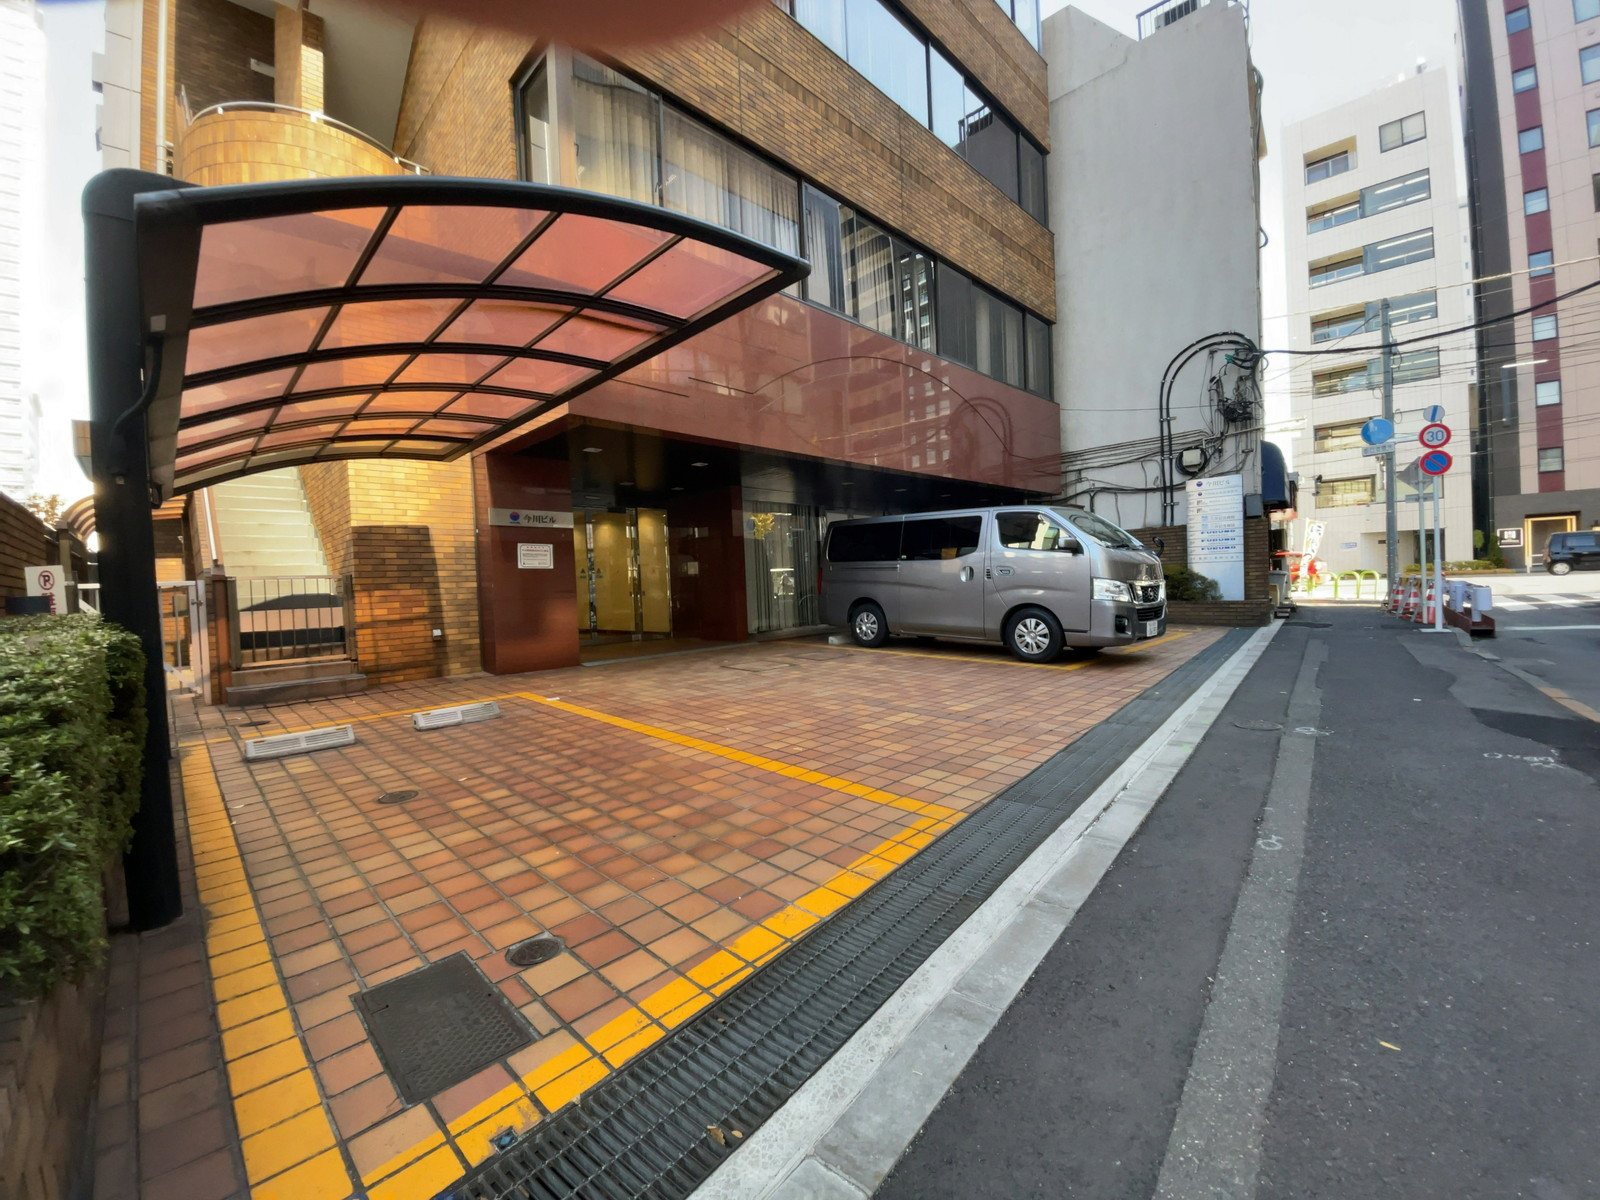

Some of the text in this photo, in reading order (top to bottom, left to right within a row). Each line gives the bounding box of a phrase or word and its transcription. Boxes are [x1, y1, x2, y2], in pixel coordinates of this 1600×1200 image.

[1426, 430, 1445, 442] 30
[523, 514, 556, 524] 今川ビル
